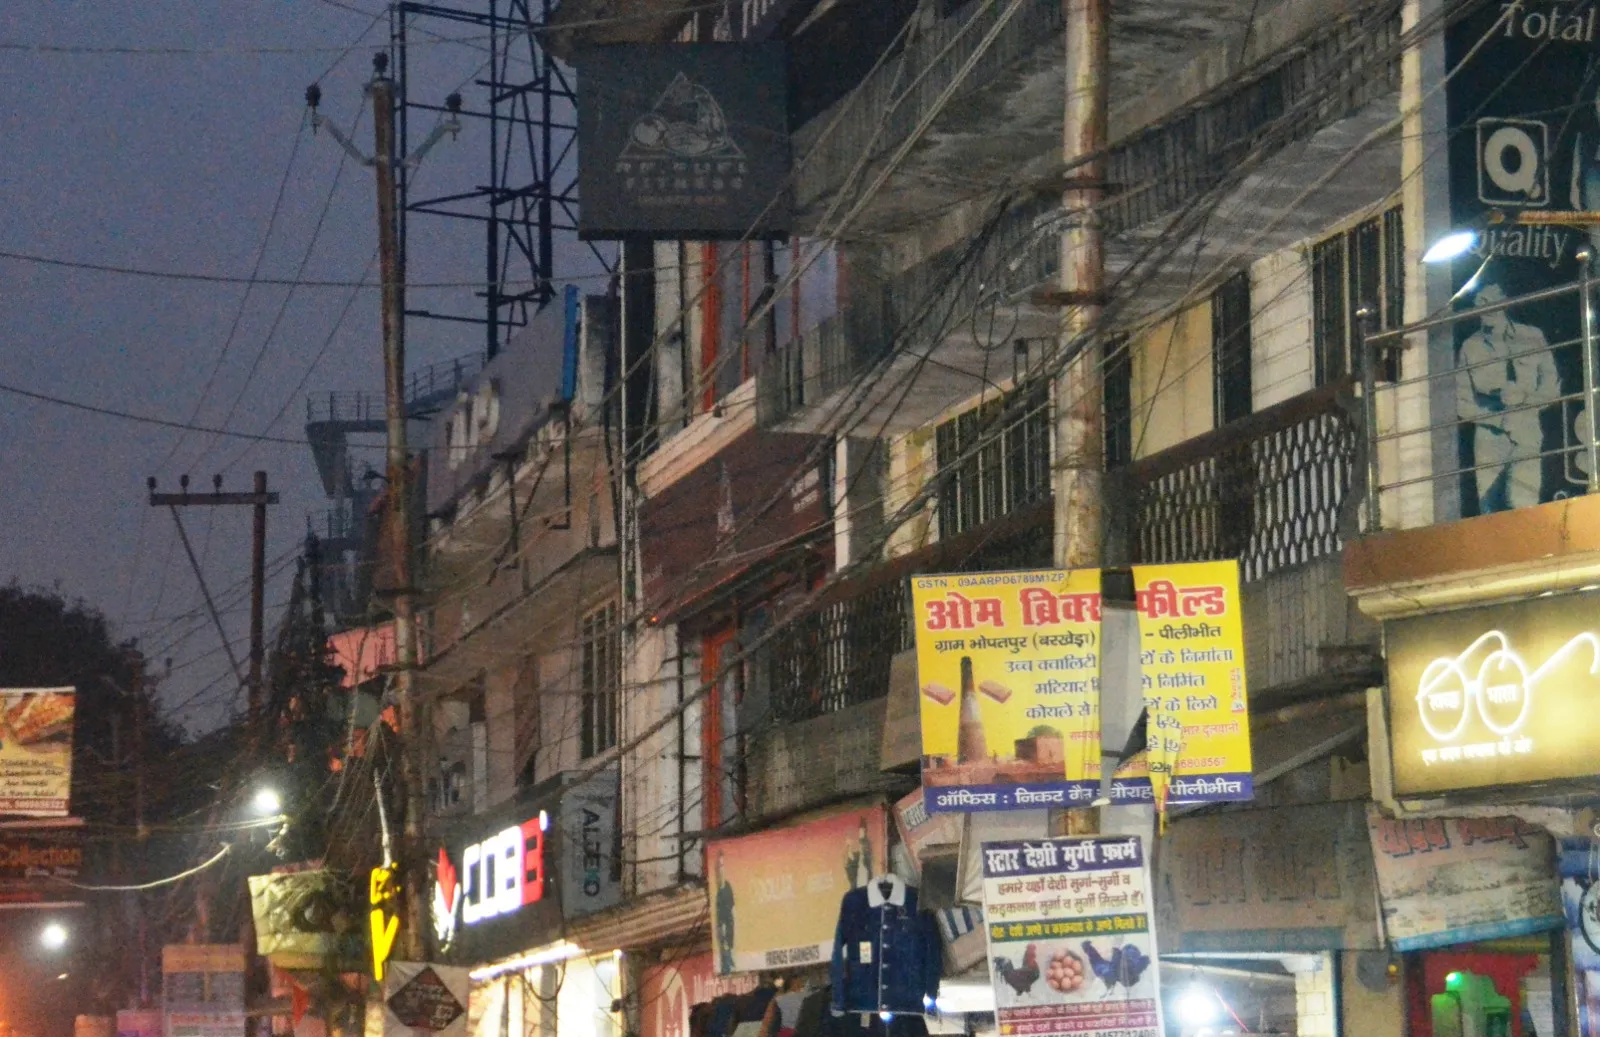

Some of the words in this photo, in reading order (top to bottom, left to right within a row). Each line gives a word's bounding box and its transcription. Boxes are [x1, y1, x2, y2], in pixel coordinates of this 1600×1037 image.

[1499, 3, 1597, 42] Total
[917, 578, 948, 589] GSTN
[925, 591, 1004, 630] ओम
[935, 639, 965, 654] ग्राम
[1159, 623, 1222, 639] पीलीभीत
[1159, 650, 1175, 664] के
[1025, 704, 1073, 718] कोयले
[1165, 697, 1180, 711] के
[937, 789, 997, 807] ऑफिस
[1015, 787, 1064, 804] निकट
[986, 848, 1020, 873] स्टार
[1023, 841, 1058, 868] देशी
[1061, 840, 1096, 871] मुर्गी
[997, 878, 1024, 895] हमारे
[1047, 874, 1067, 891] देशी
